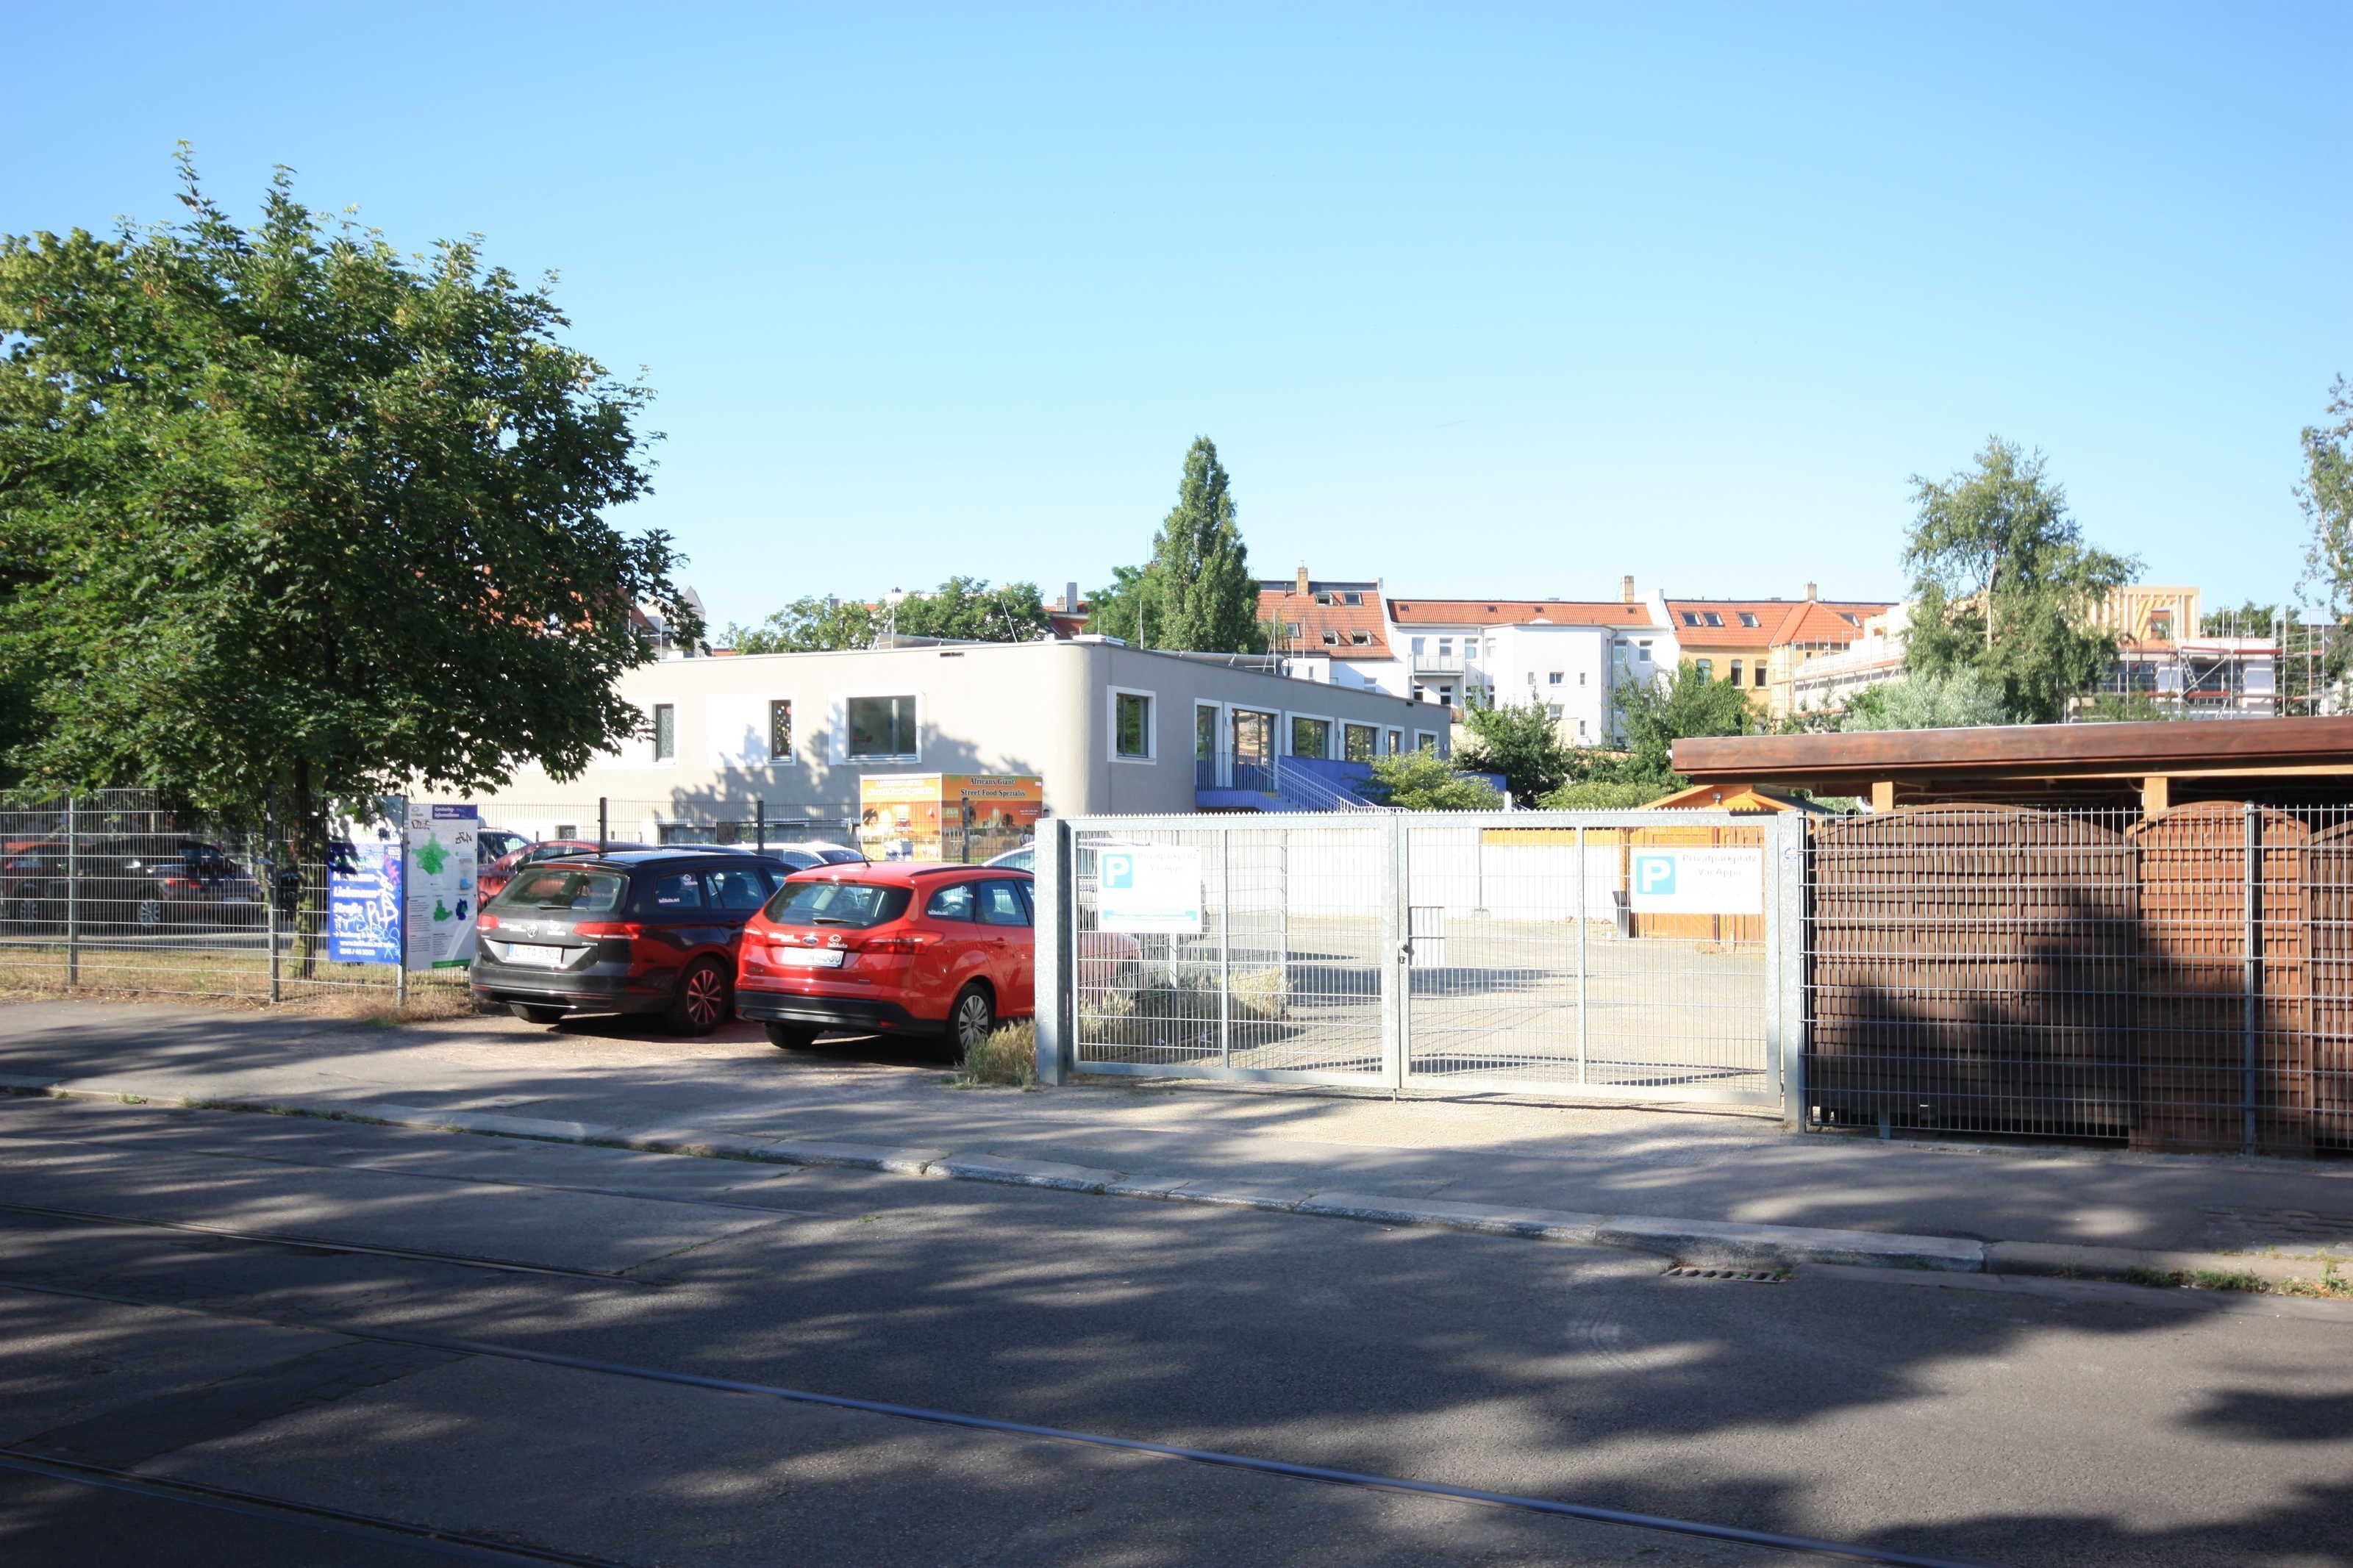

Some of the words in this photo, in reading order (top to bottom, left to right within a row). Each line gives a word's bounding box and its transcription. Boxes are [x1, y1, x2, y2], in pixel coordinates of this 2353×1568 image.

[998, 778, 1015, 786] Giant
[960, 788, 980, 796] Street
[1682, 854, 1757, 864] Privatparkplatz
